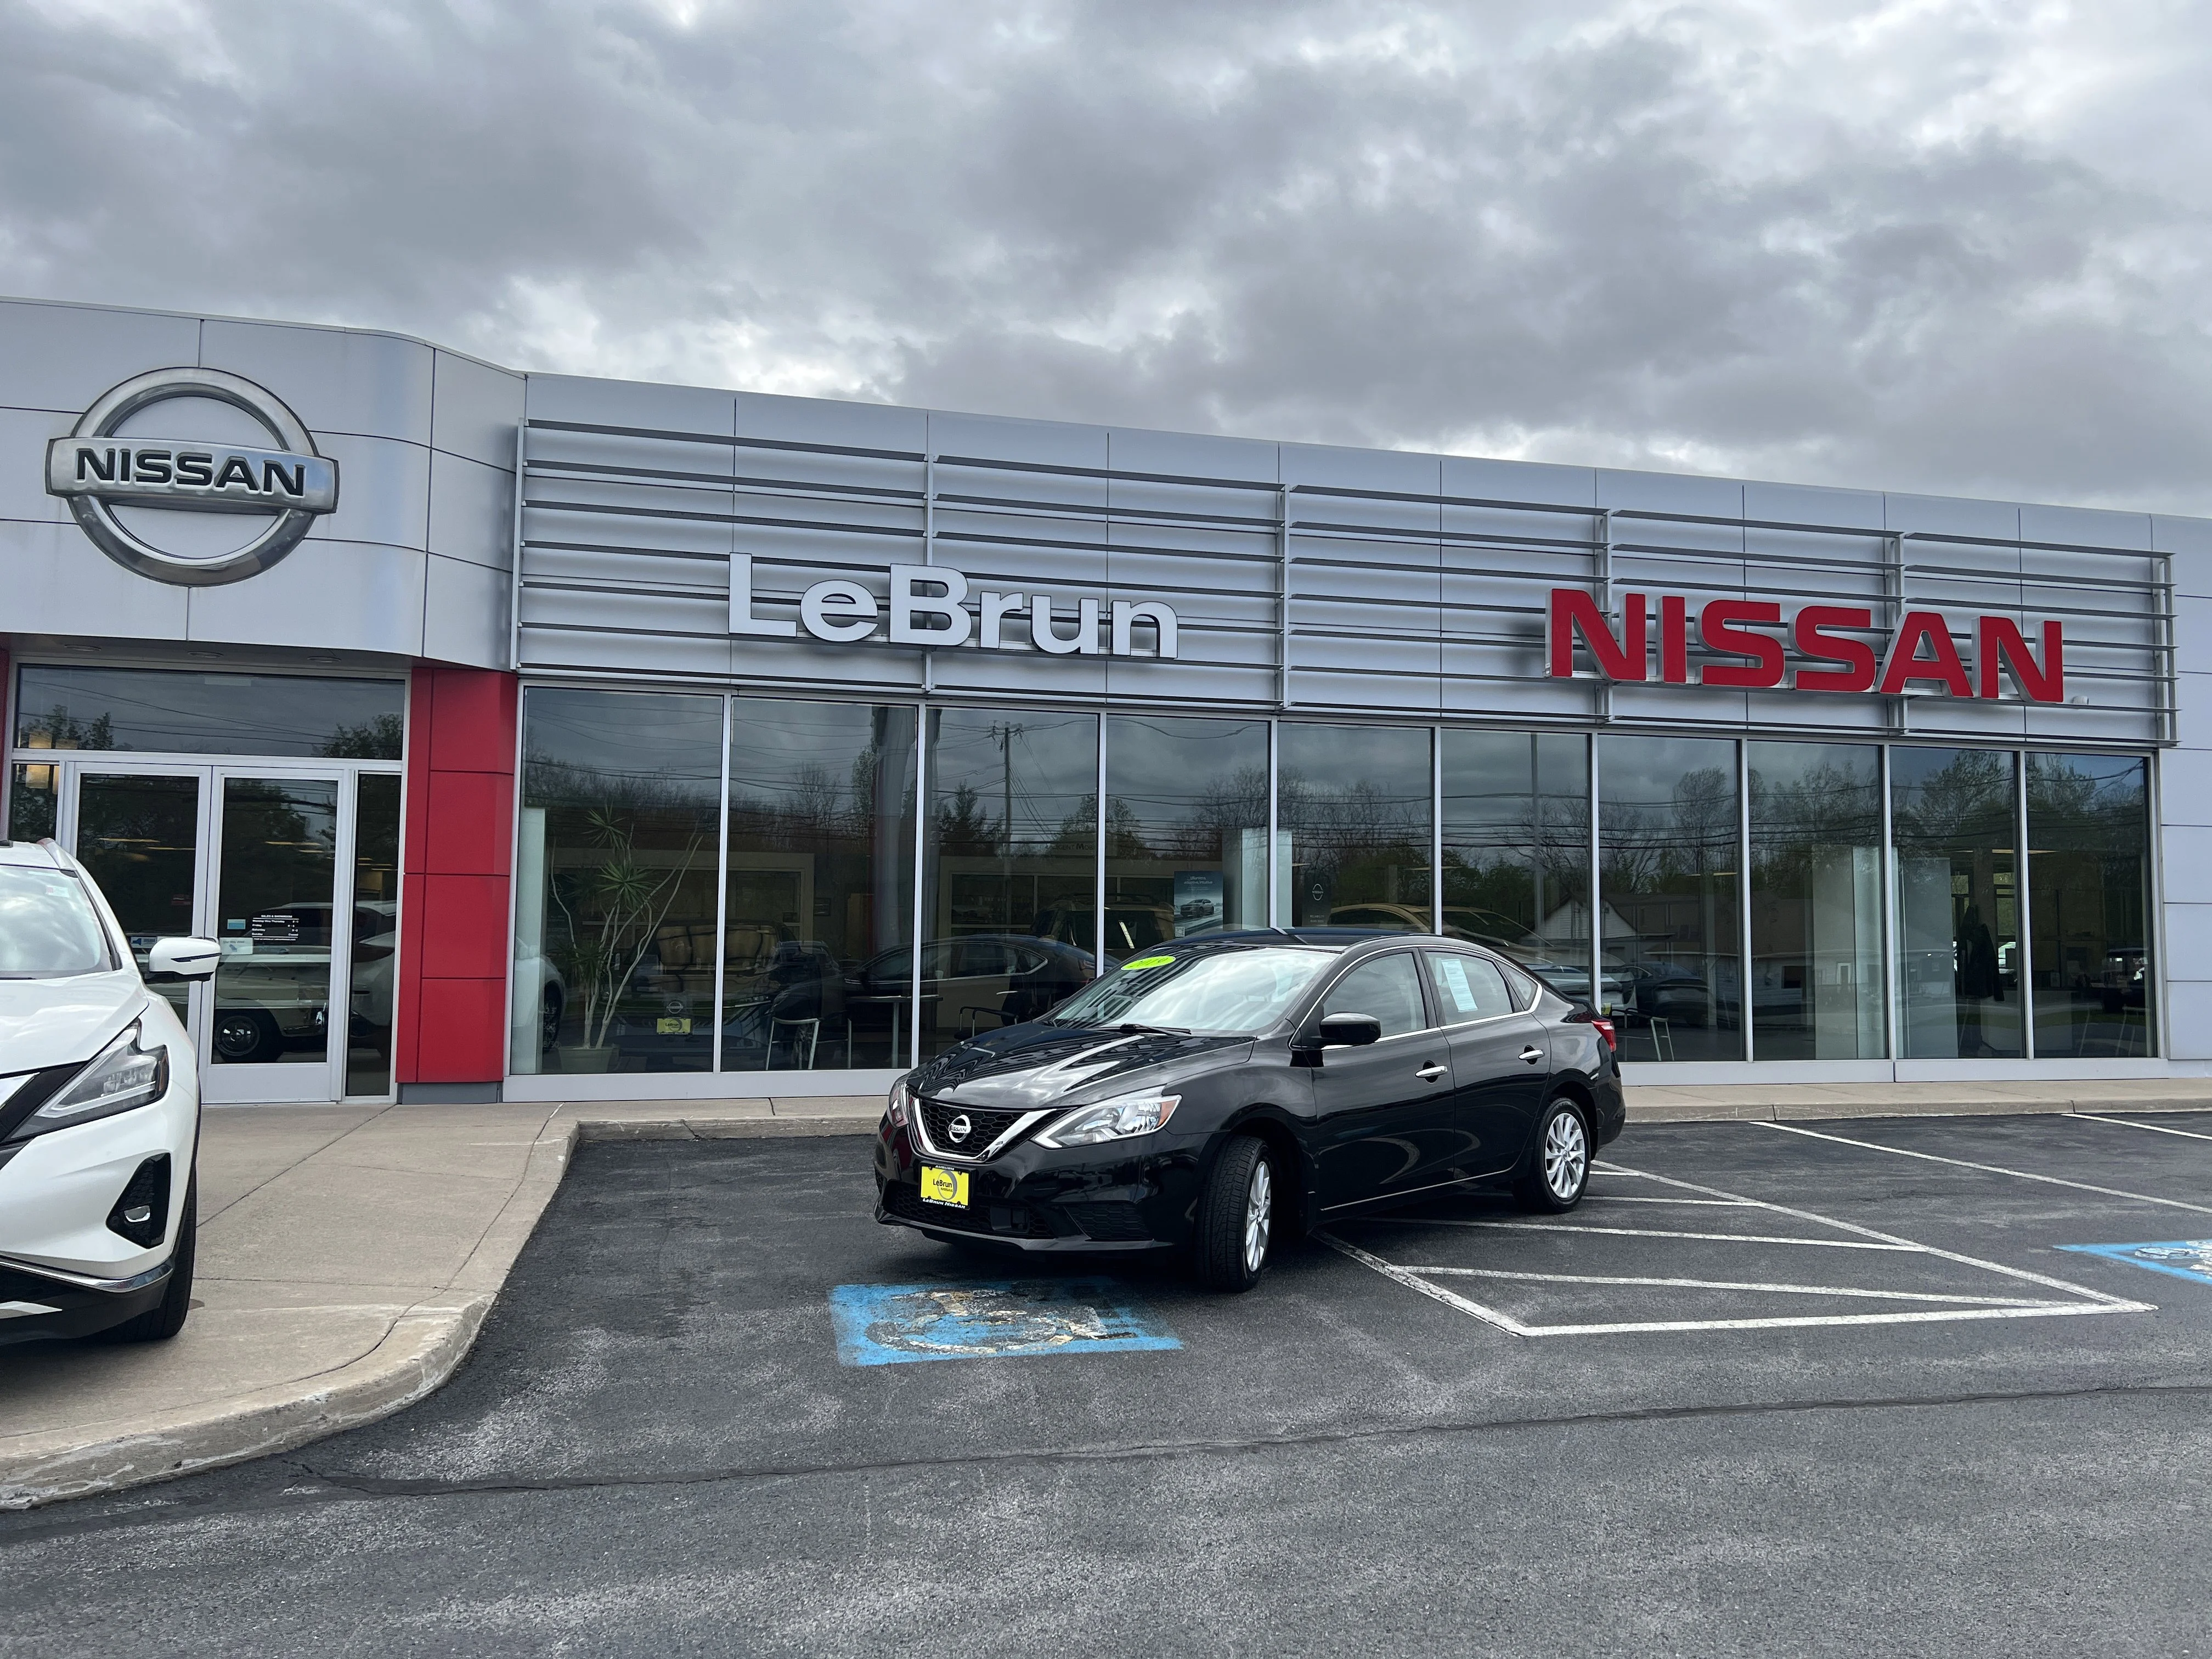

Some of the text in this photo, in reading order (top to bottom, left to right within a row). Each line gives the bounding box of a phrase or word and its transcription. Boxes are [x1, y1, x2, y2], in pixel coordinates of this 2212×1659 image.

[75, 448, 305, 496] NISSAN
[729, 552, 1178, 658] LeBrun
[1545, 588, 2063, 703] NISSAN
[933, 1178, 952, 1188] LeBrun
